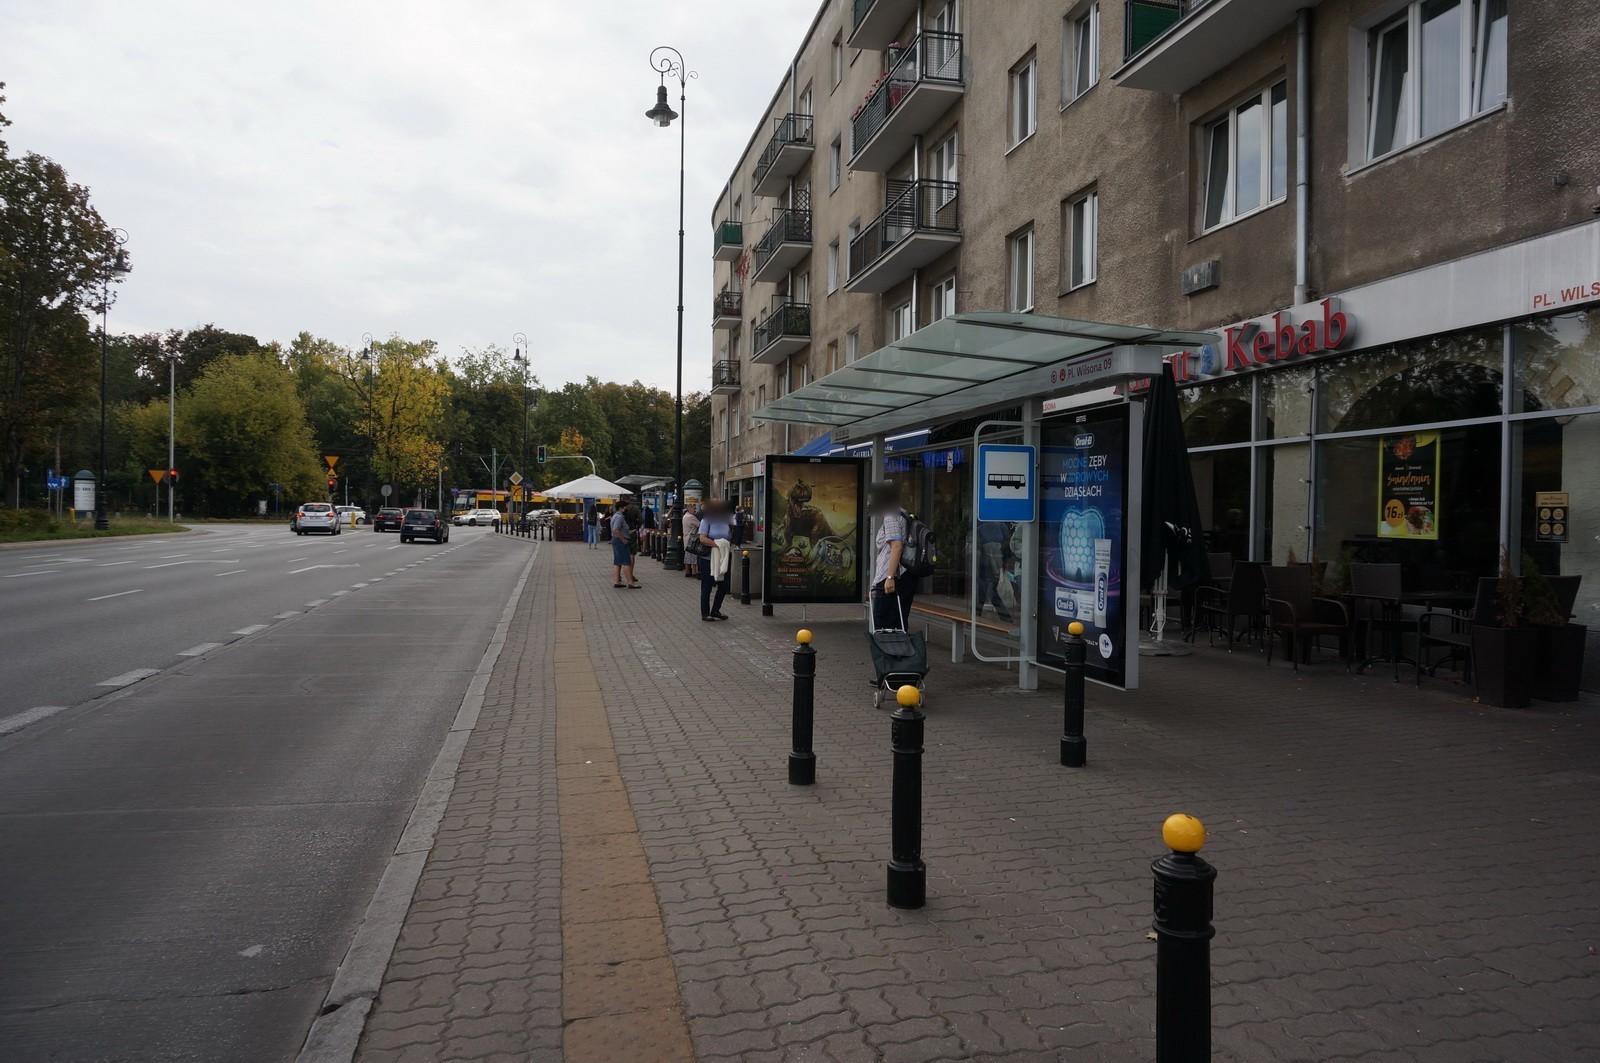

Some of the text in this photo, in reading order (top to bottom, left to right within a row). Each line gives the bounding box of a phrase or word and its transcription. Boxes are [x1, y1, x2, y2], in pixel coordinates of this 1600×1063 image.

[1533, 293, 1556, 308] PL.
[1223, 297, 1348, 371] Kebab
[1076, 363, 1103, 377] Wilsona
[1103, 358, 1112, 370] 09
[1088, 454, 1107, 470] ZĘBY
[1060, 472, 1067, 483] W
[1064, 485, 1102, 500] DZIĄSŁACH
[1057, 598, 1074, 610] Oral-B
